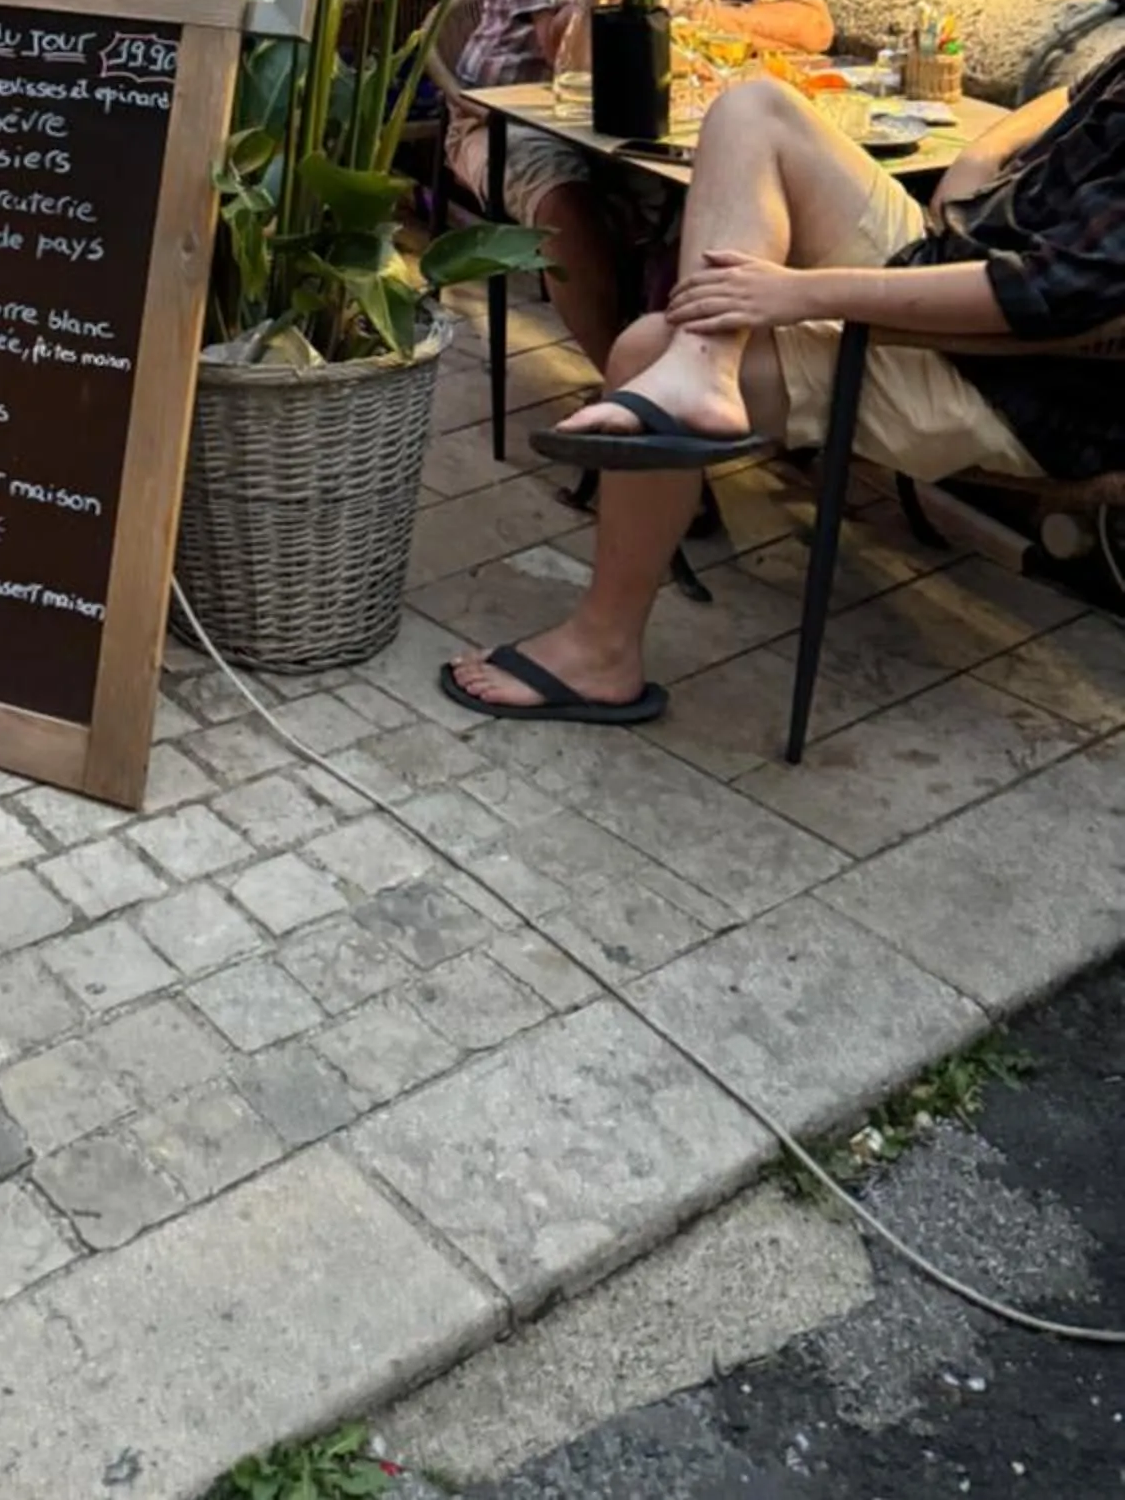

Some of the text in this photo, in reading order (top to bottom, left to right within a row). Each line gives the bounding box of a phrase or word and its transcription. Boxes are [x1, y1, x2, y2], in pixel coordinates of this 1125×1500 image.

[35, 232, 104, 262] pays
[47, 307, 115, 339] blanc
[9, 478, 103, 517] maison
